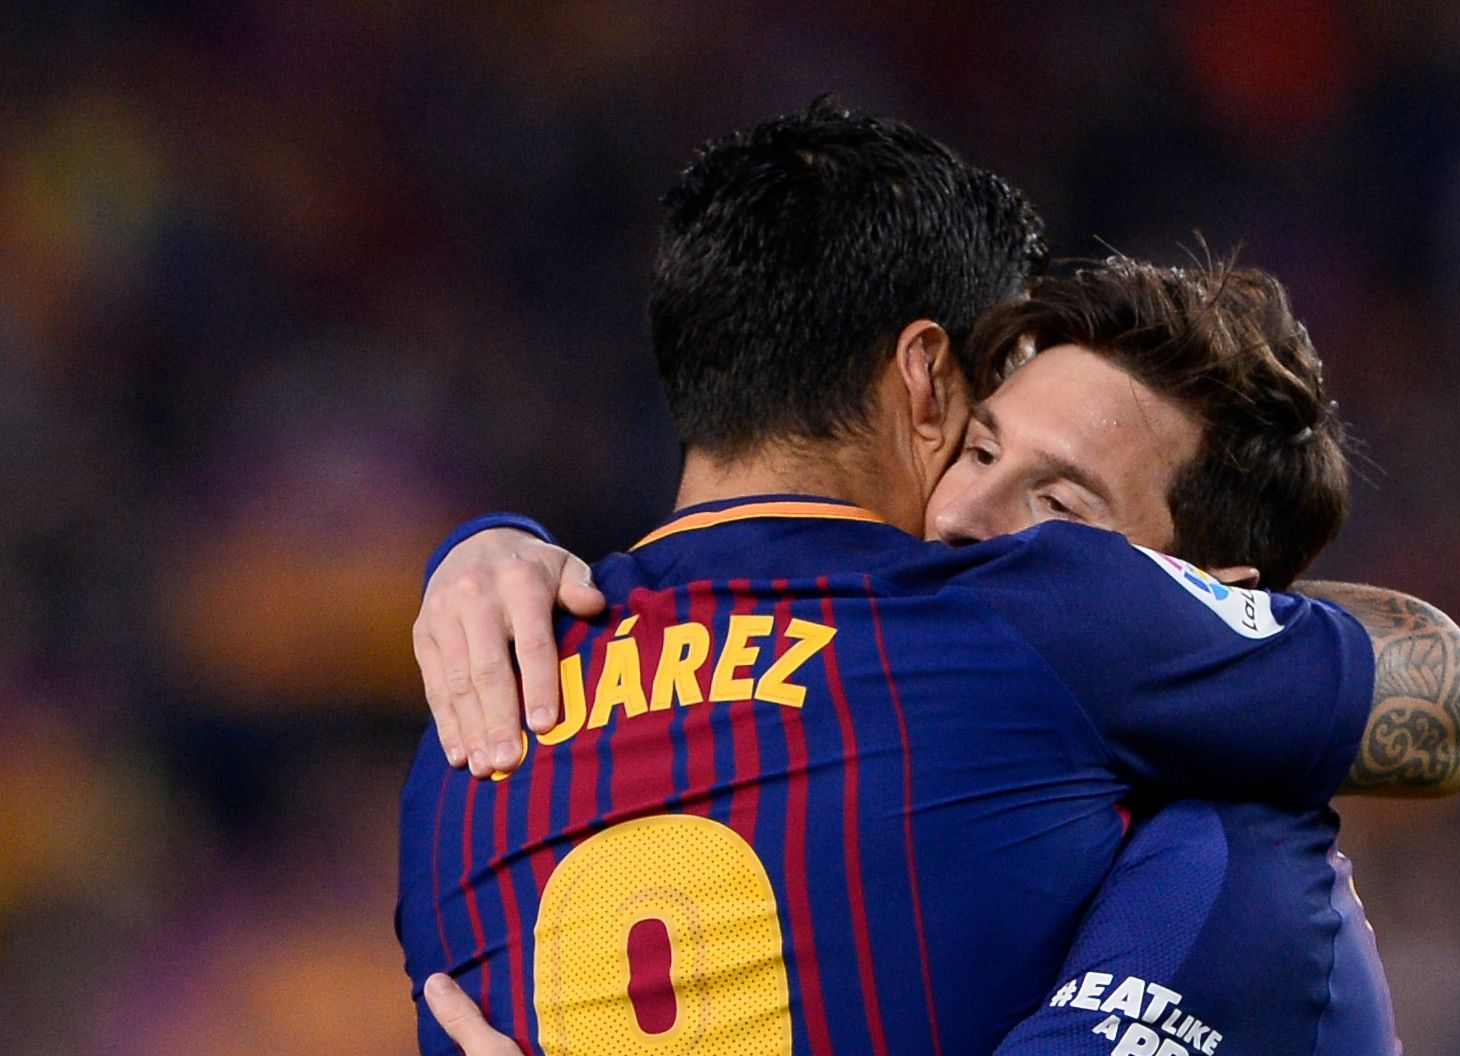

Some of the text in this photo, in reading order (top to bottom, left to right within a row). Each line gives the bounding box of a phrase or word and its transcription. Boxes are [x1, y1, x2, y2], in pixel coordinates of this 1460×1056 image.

[490, 613, 838, 781] UÁREZ
[1049, 971, 1223, 1056] #EAT LIKE
[1091, 1014, 1122, 1042] A
